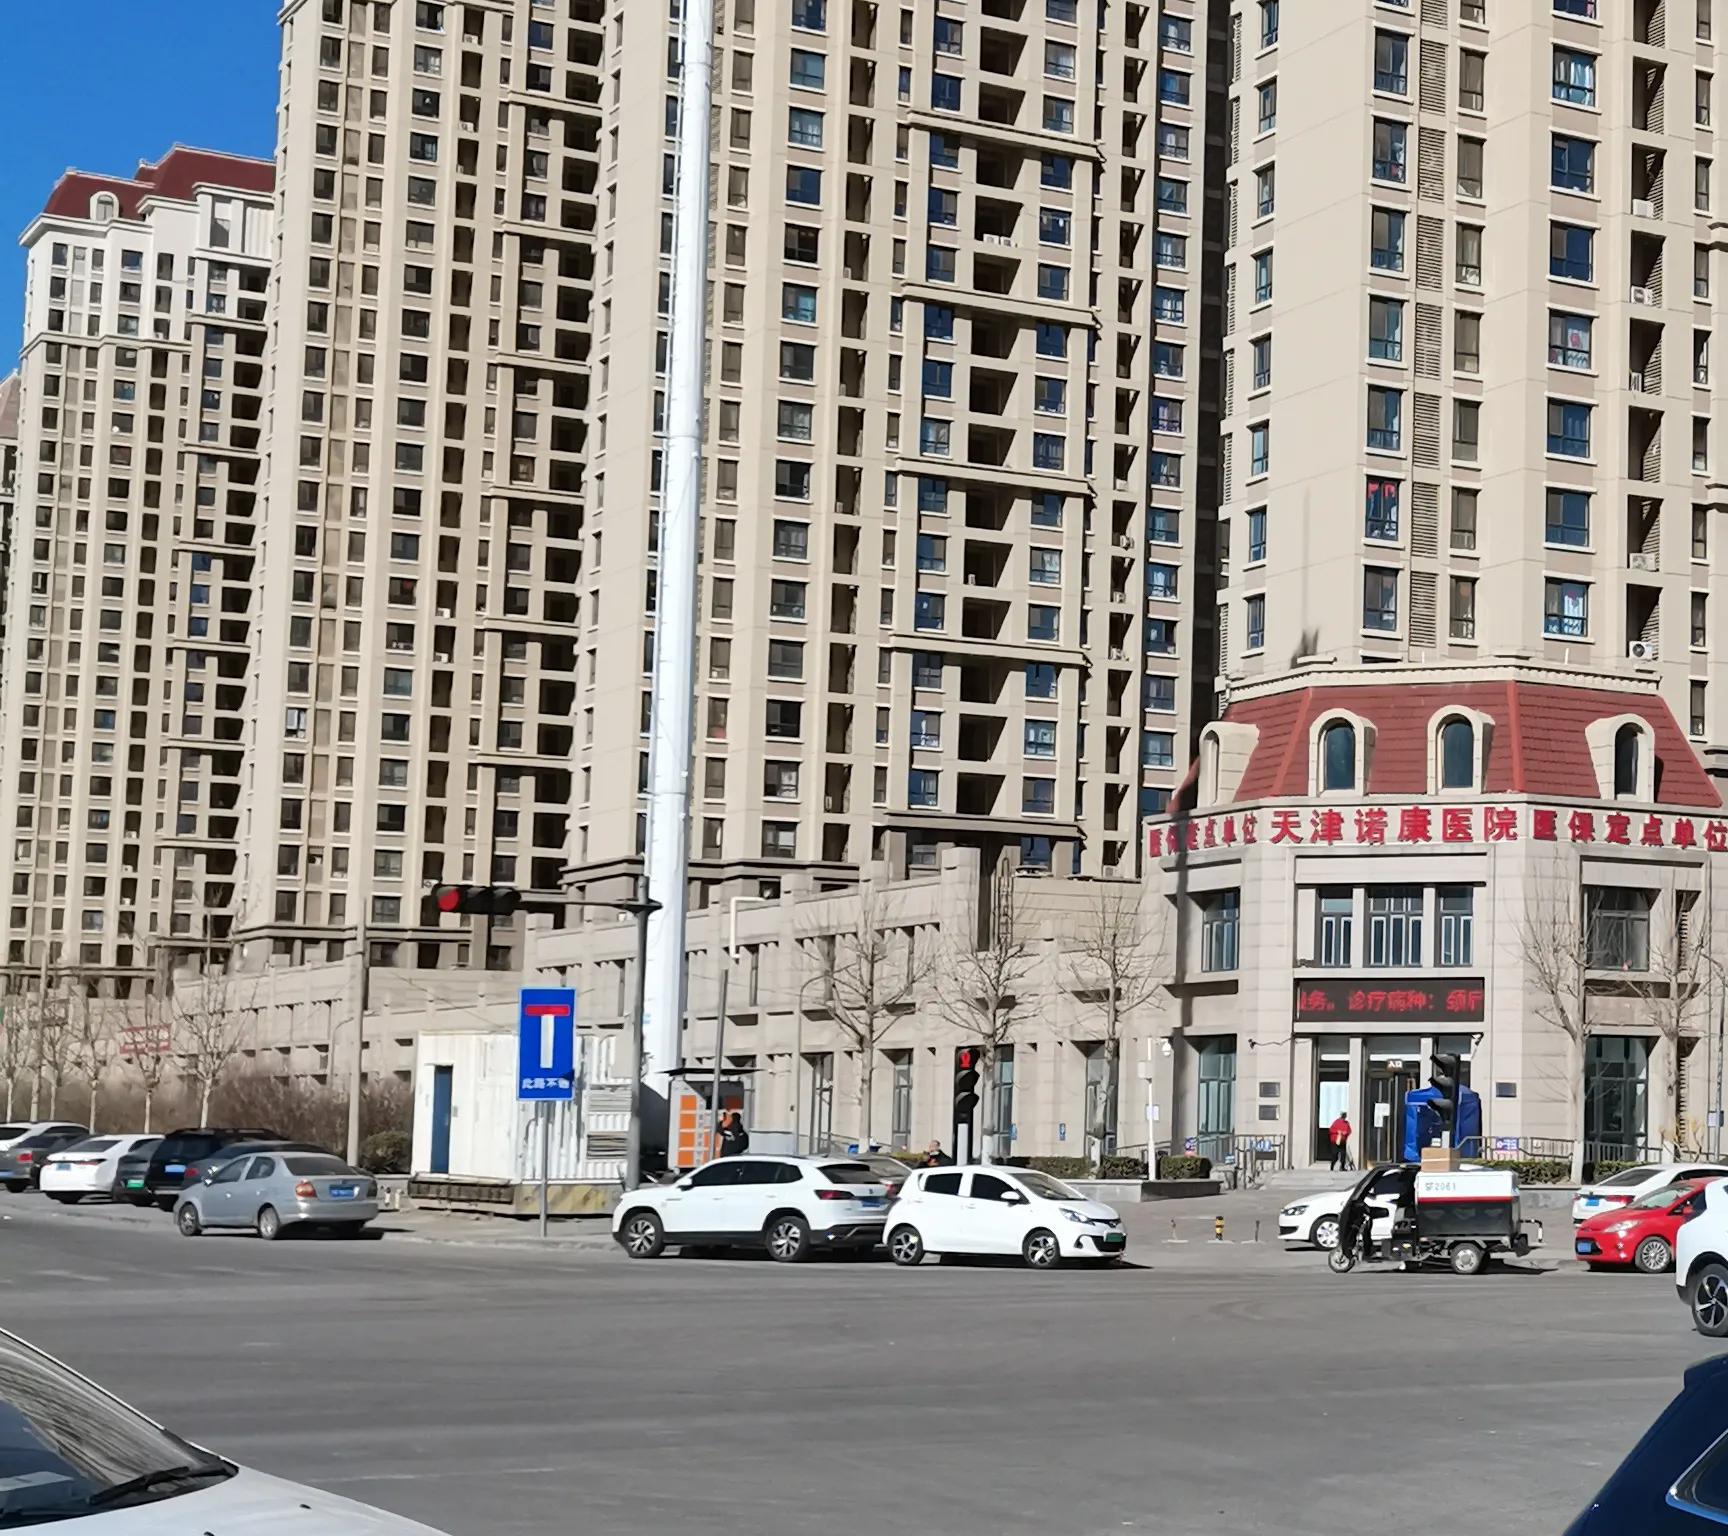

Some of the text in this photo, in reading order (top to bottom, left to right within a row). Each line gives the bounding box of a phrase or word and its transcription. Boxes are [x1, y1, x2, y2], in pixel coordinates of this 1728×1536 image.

[1149, 811, 1258, 858] 医保定点单位
[1271, 806, 1517, 846] 天津诺康医院
